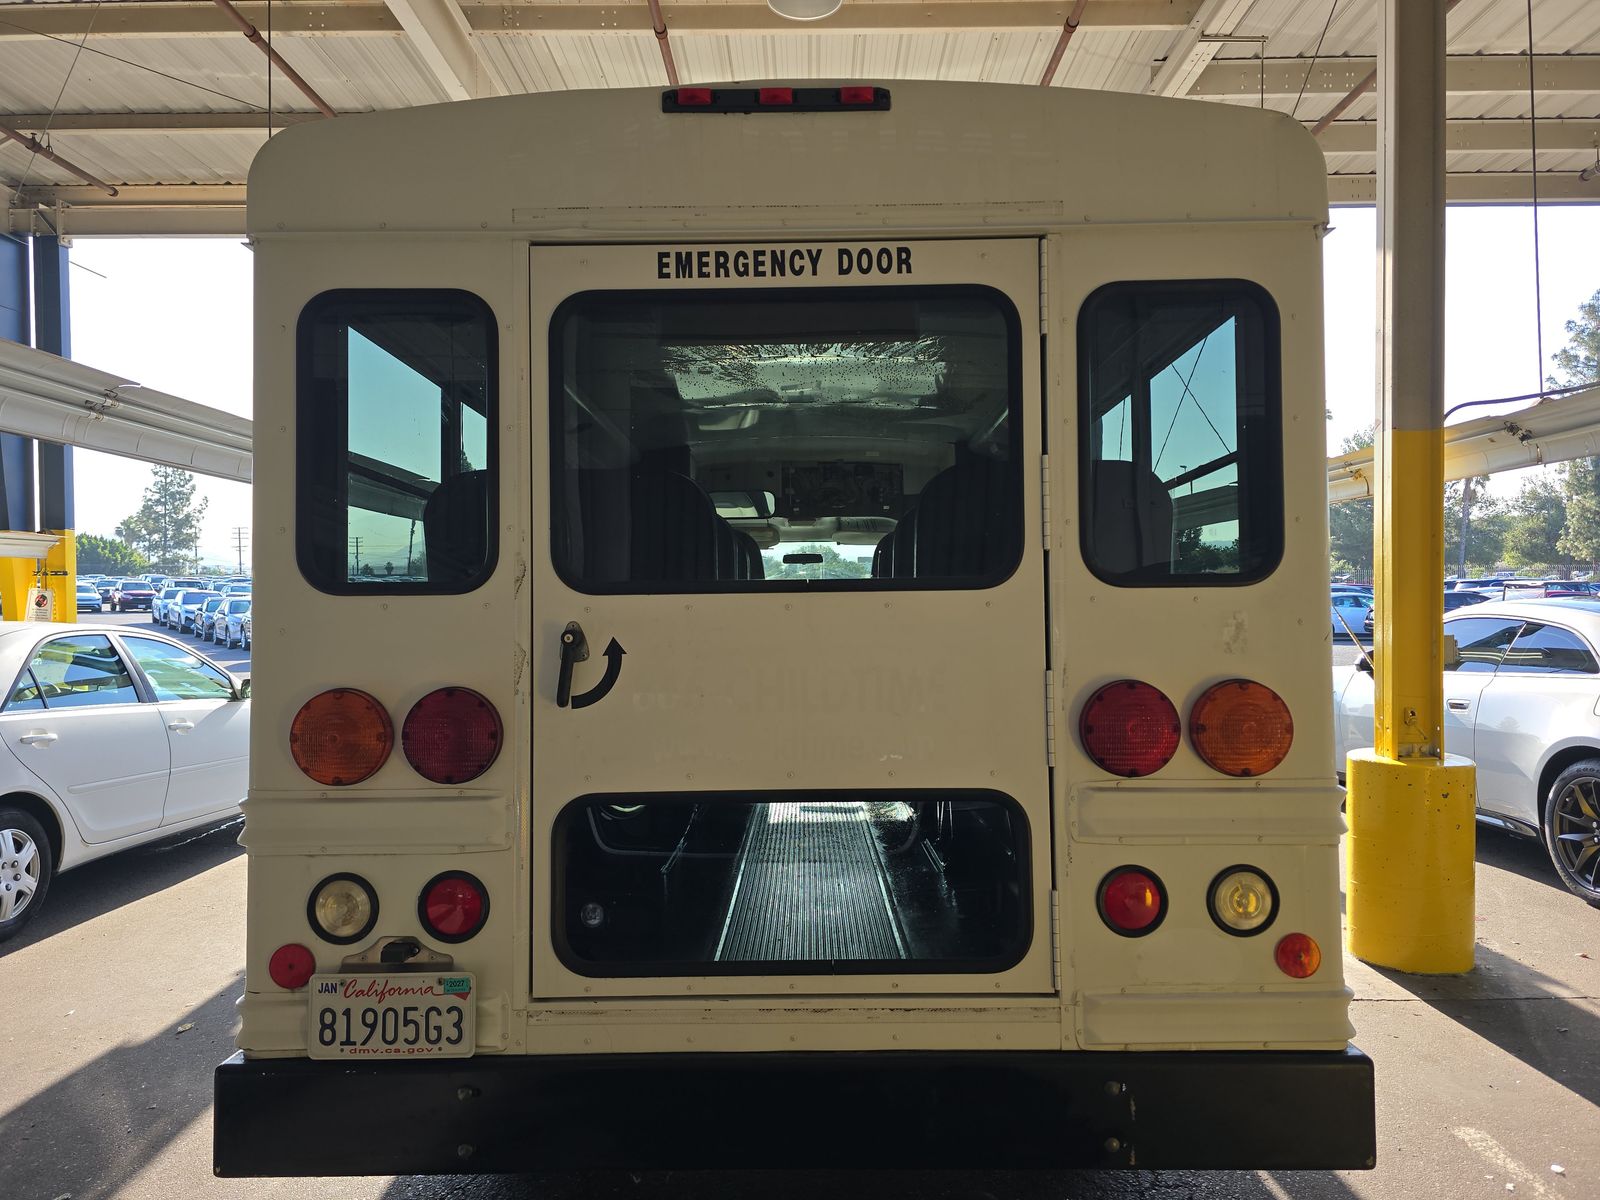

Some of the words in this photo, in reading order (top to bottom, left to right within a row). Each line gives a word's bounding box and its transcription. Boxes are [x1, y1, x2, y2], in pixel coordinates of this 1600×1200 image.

[657, 249, 823, 279] EMERGENCY
[838, 247, 912, 276] DOOR
[318, 982, 338, 994] JAN
[343, 979, 442, 1004] California
[449, 980, 464, 988] 2027
[319, 1006, 464, 1046] 81905G3
[349, 1046, 434, 1055] dmv.ca.gov
